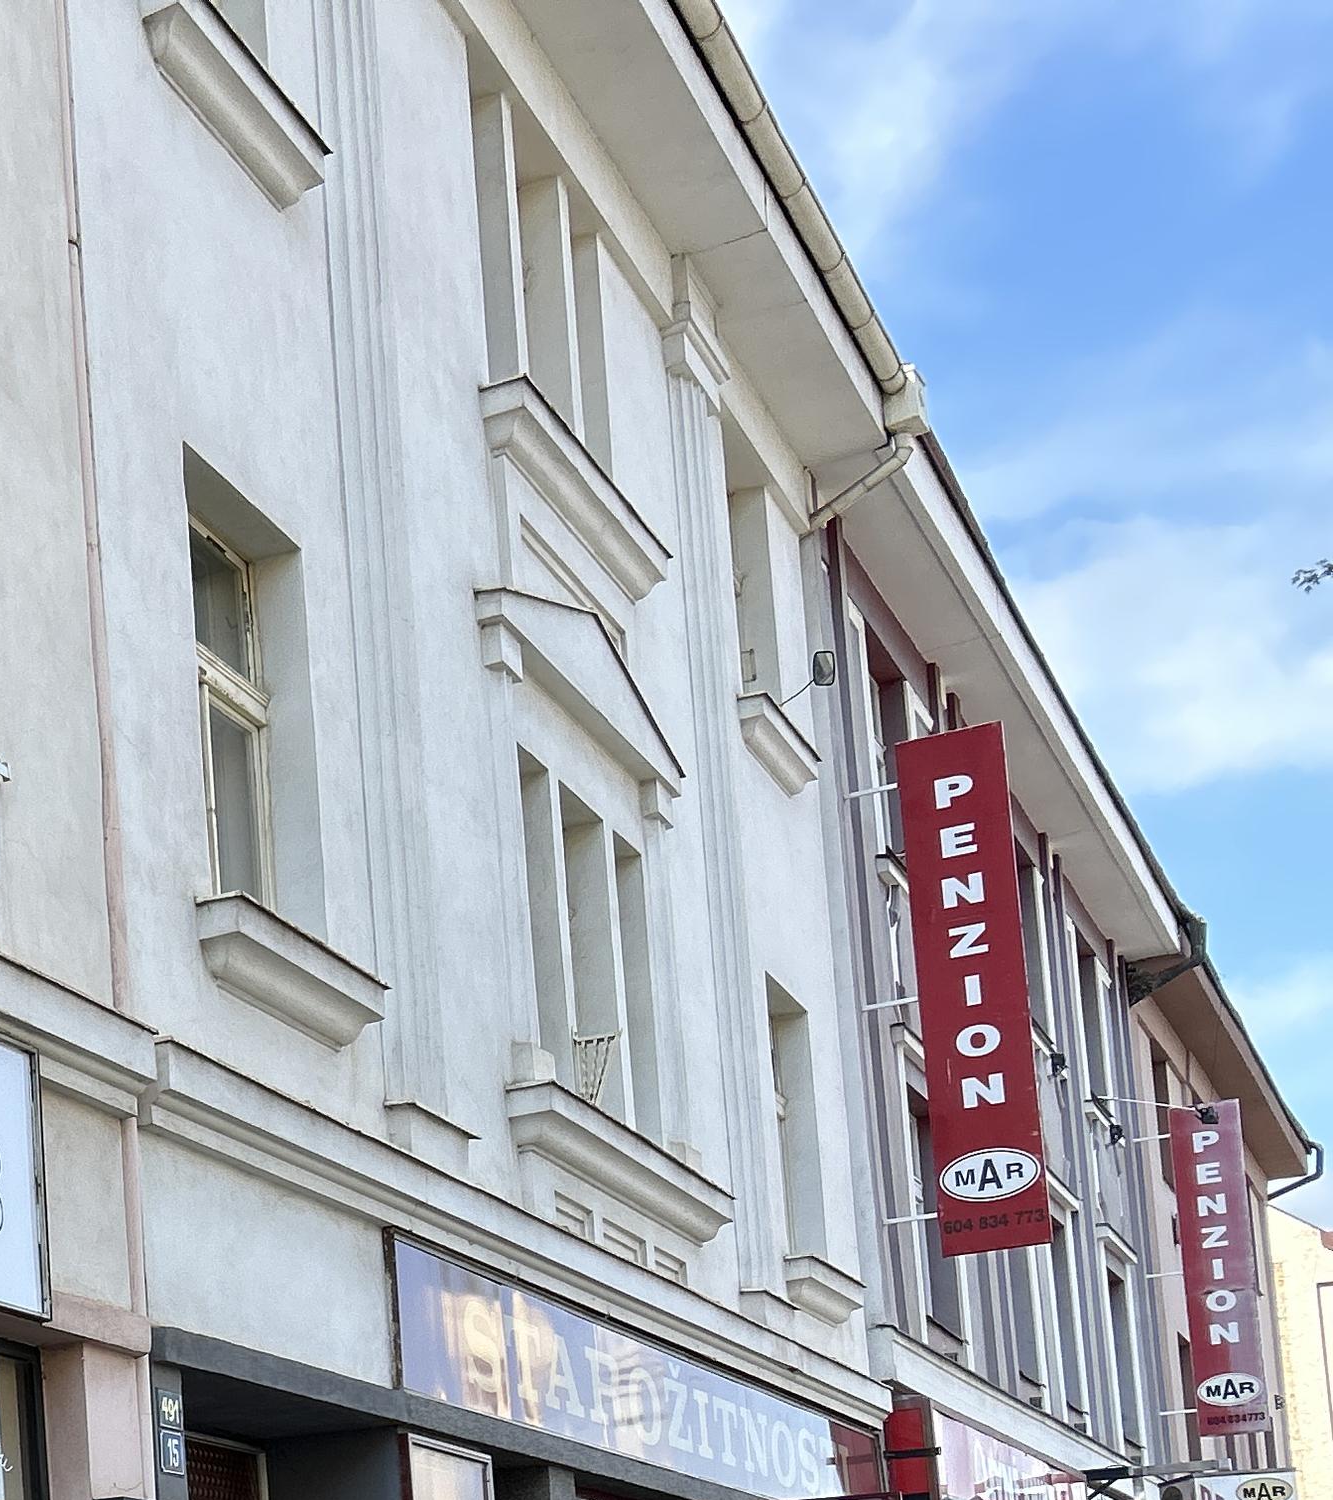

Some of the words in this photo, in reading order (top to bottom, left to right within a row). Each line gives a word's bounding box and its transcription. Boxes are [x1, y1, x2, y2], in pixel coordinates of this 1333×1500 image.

[934, 775, 1005, 1109] PENZION
[954, 1158, 1024, 1192] MAR
[1014, 1208, 1045, 1224] 773
[1192, 1131, 1239, 1345] PENZION
[1205, 1378, 1255, 1400] MAR
[161, 1396, 180, 1424] 491
[167, 1438, 179, 1467] 15
[1242, 1482, 1287, 1500] MAR
